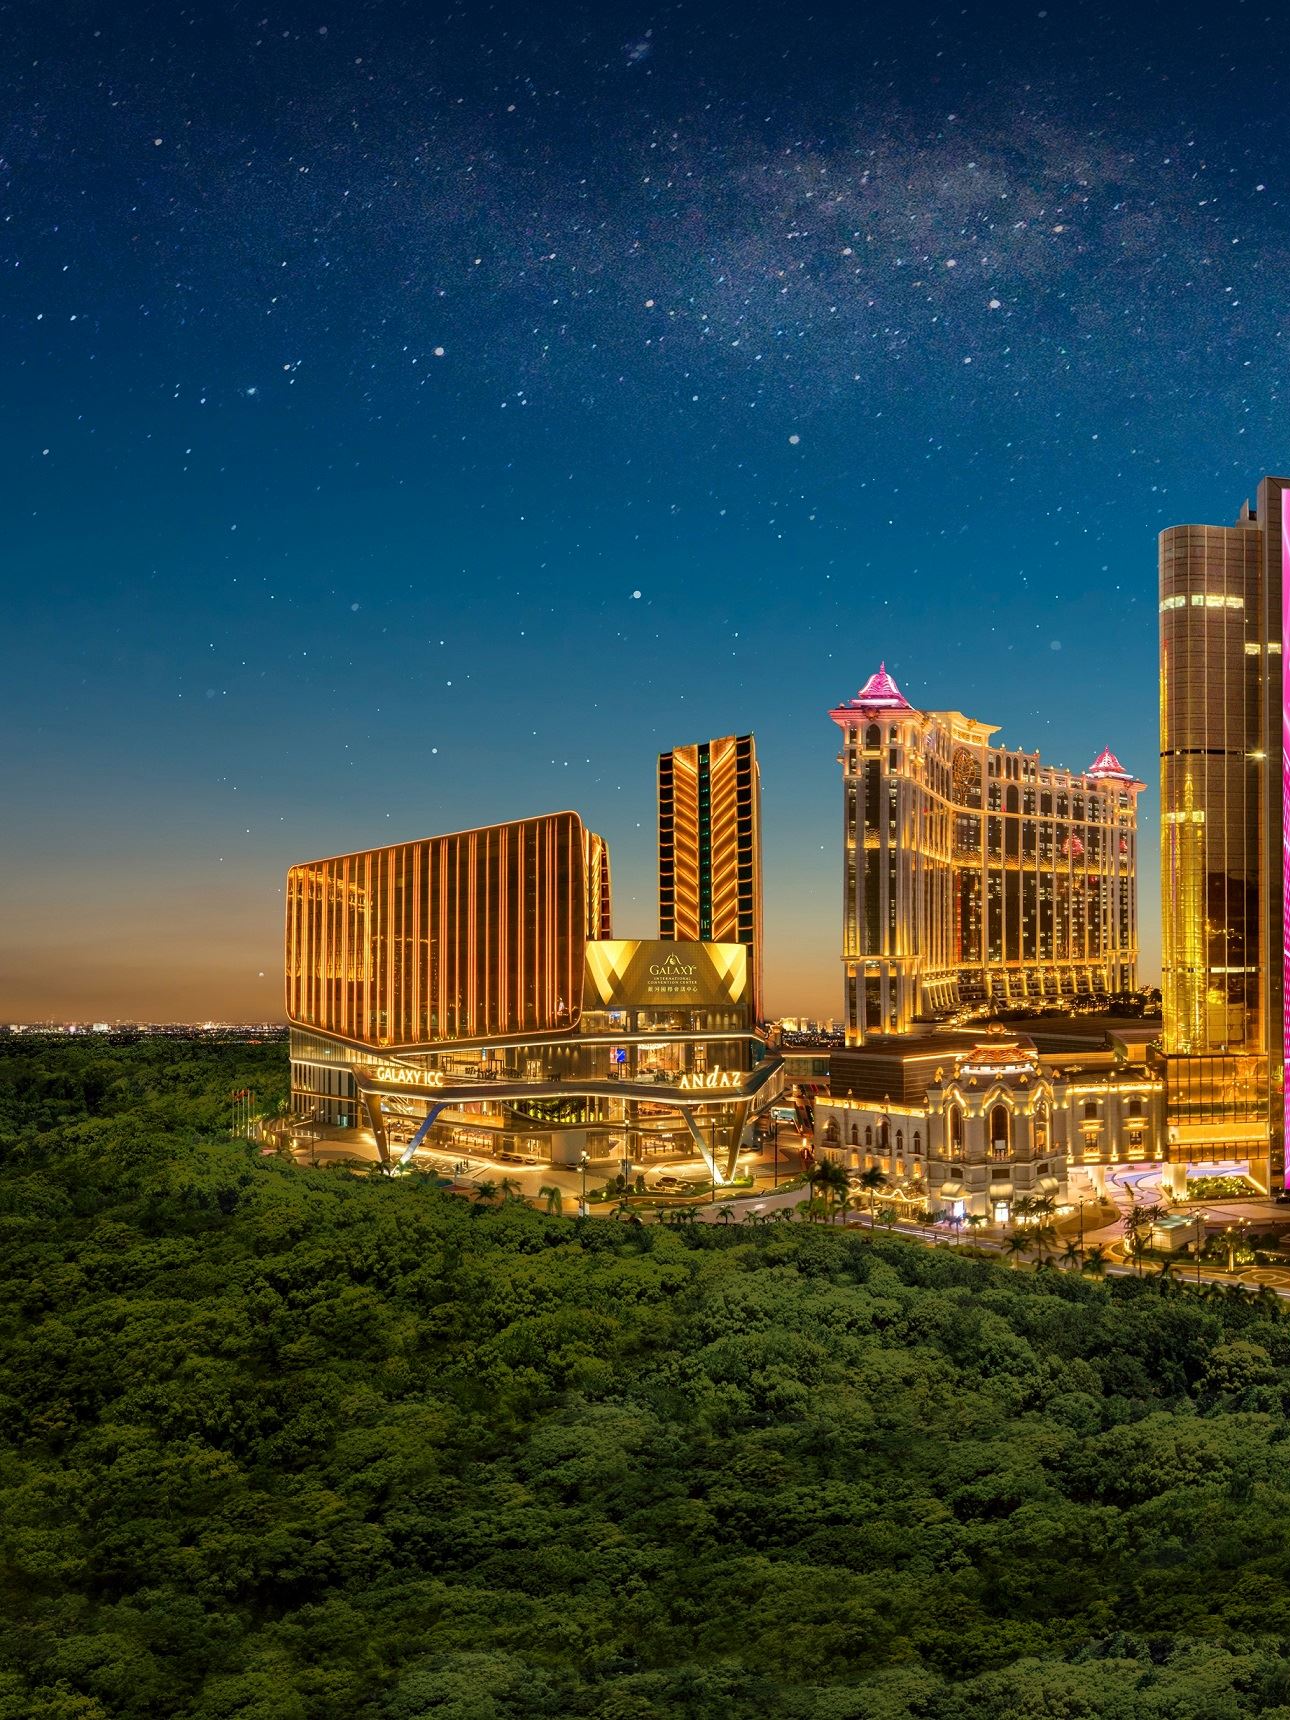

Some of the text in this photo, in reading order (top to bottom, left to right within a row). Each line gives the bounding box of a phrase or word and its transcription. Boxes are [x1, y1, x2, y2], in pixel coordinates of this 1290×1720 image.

[649, 964, 695, 976] GALAXY
[377, 1066, 445, 1088] GALAXY ICC
